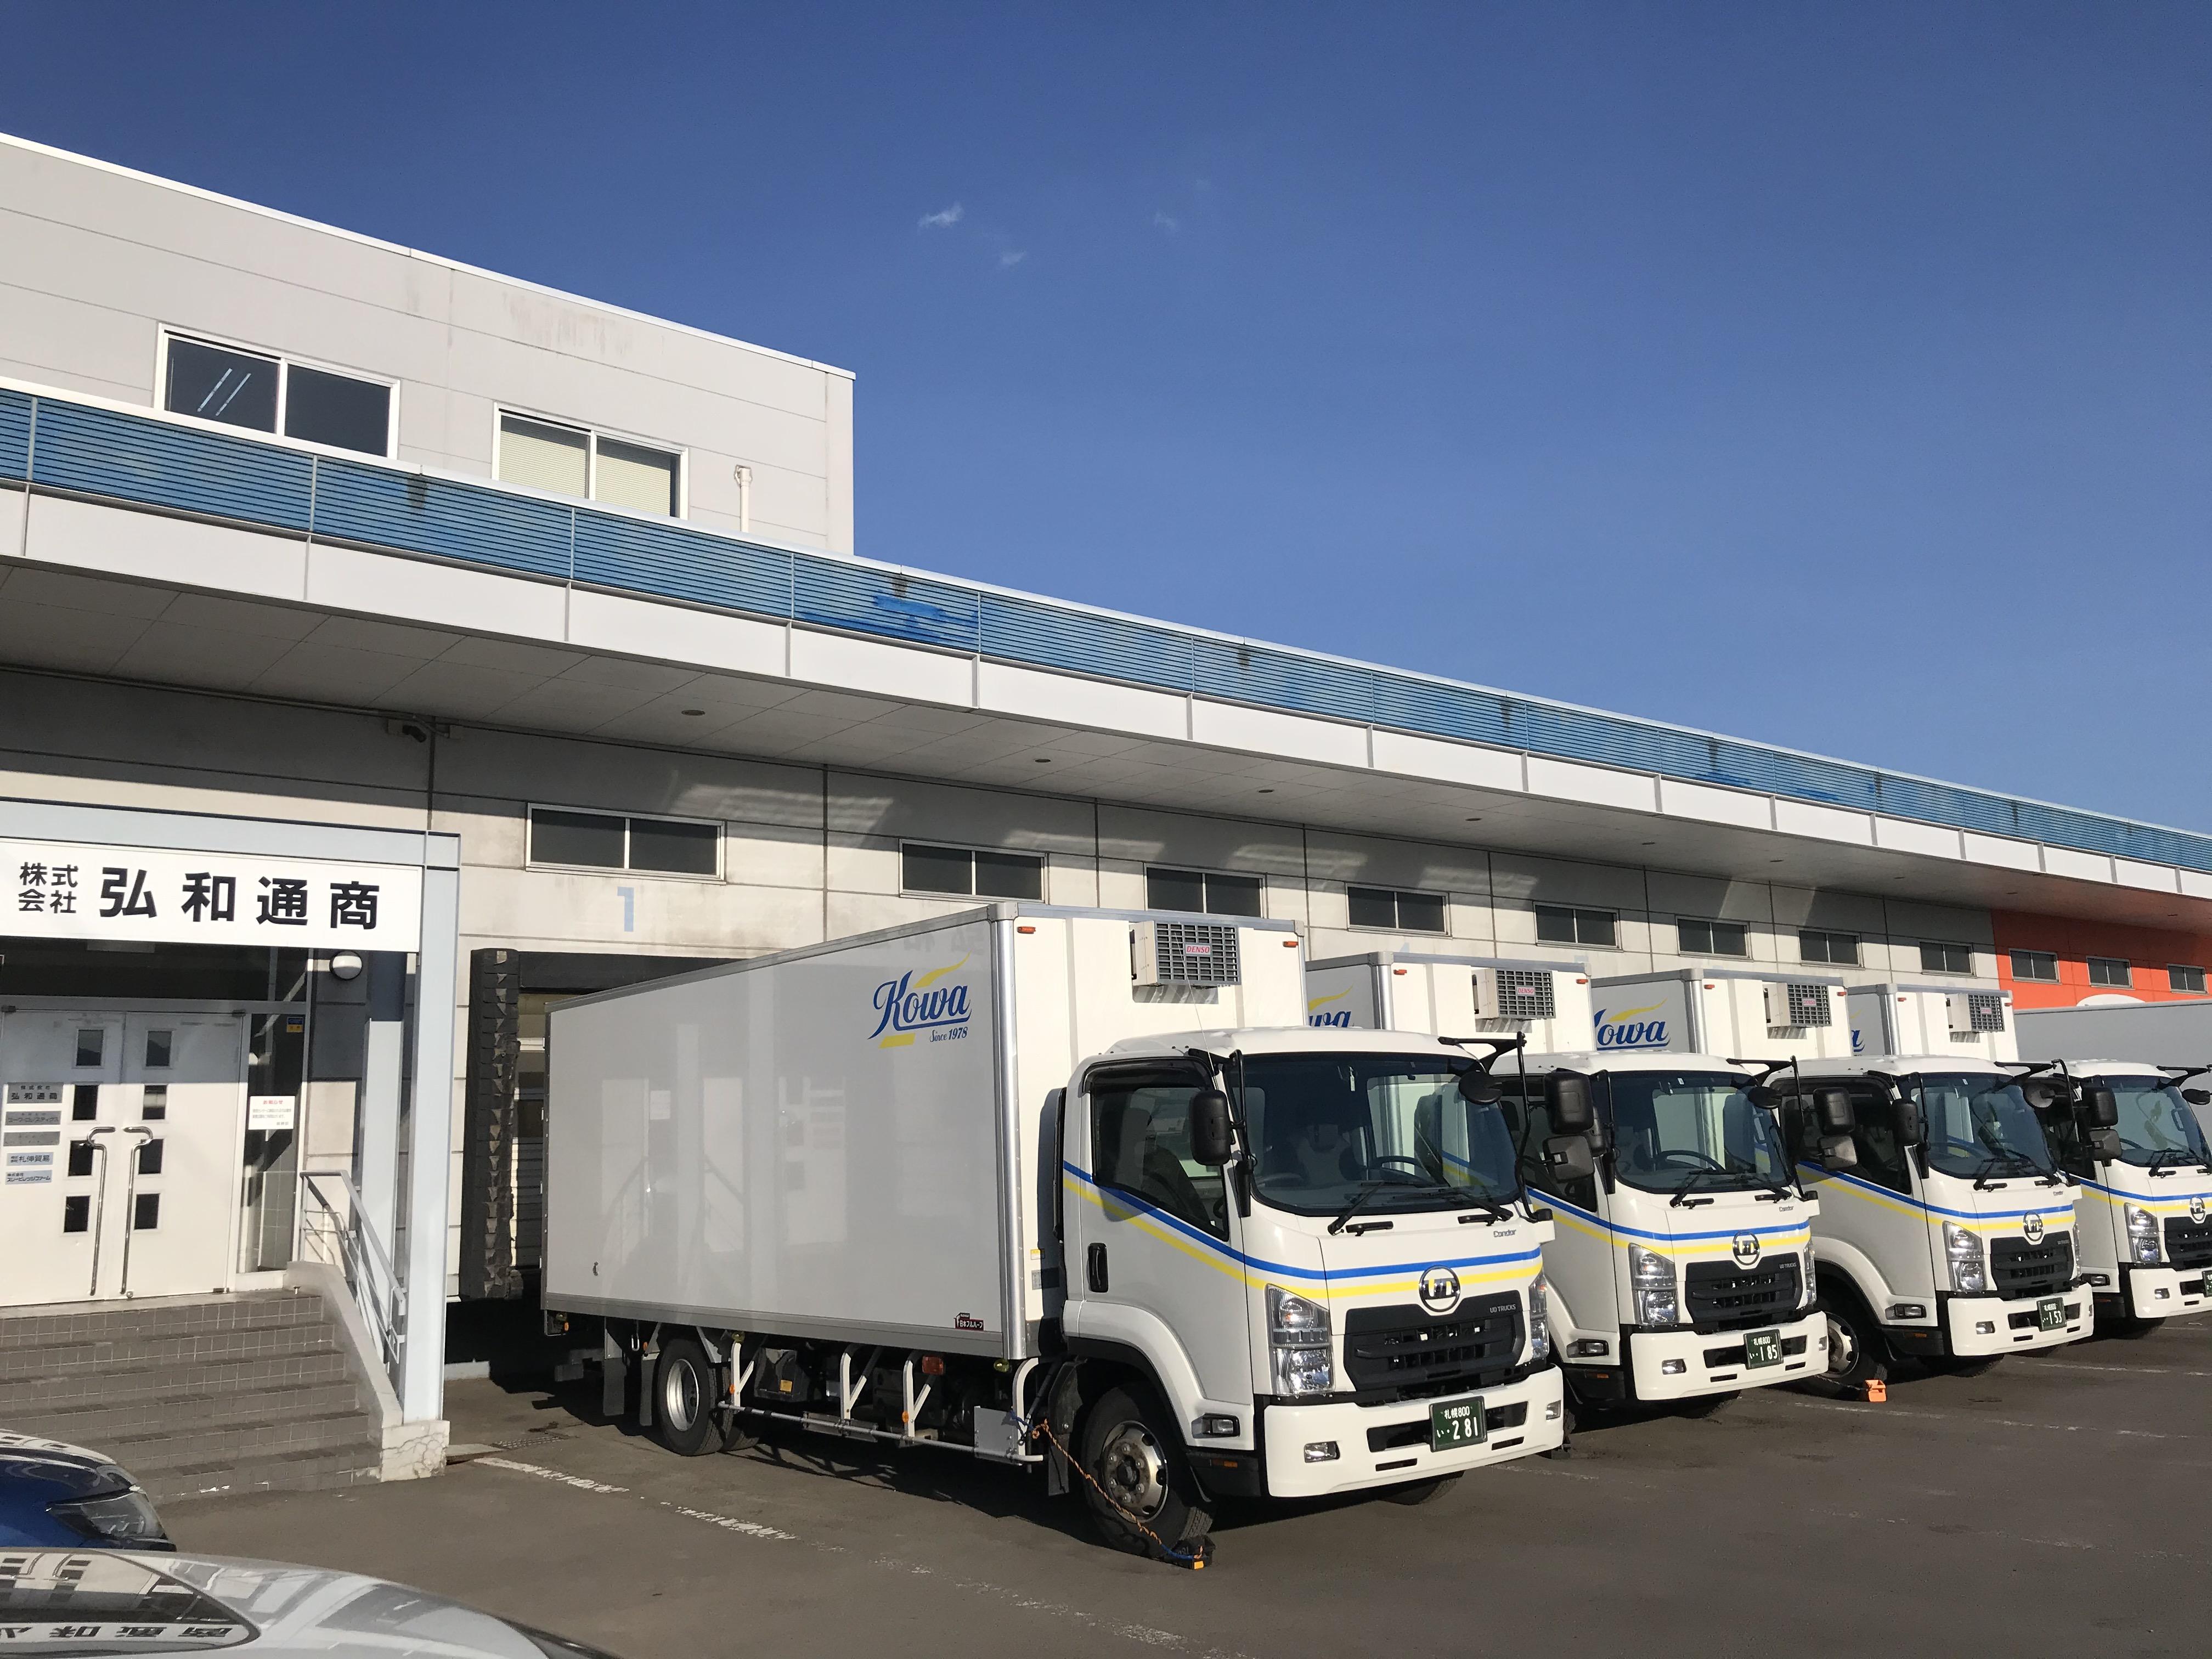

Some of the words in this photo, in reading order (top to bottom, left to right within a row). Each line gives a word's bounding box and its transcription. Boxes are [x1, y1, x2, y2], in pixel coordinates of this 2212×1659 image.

[20, 862, 79, 888] 株式
[18, 889, 77, 913] 会社
[99, 867, 380, 930] 弘和通商
[617, 886, 634, 932] 1
[867, 969, 972, 1040] Kowa
[930, 1029, 948, 1042] Since
[949, 1026, 968, 1040] 1978
[1493, 1229, 1516, 1238] Condor
[1497, 1304, 1516, 1312] TRUCKS
